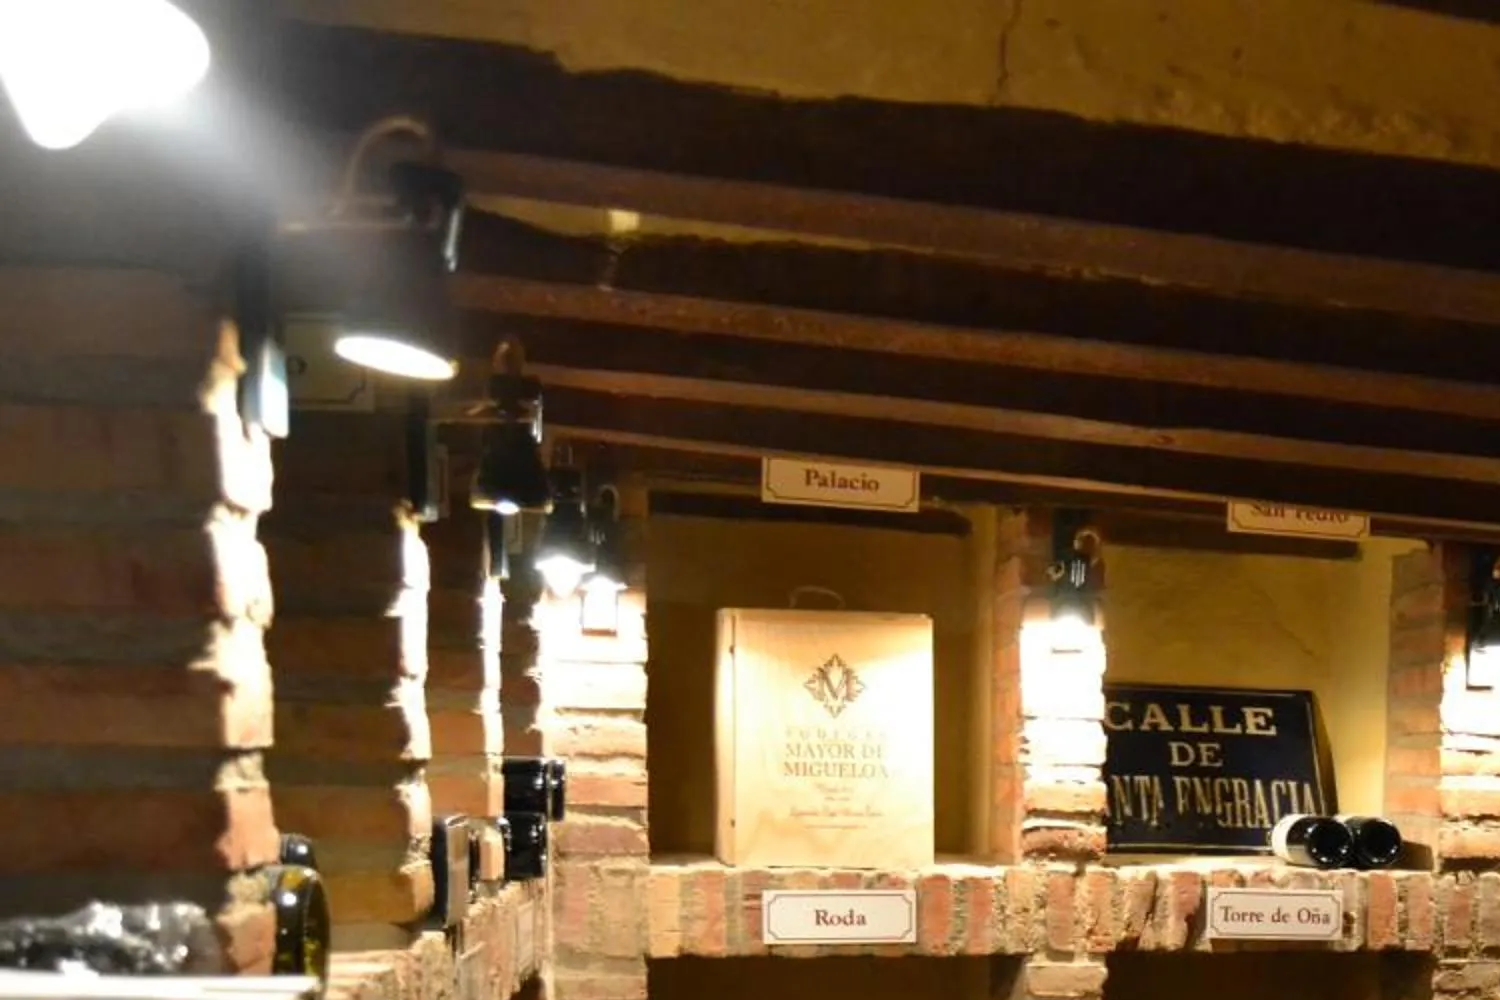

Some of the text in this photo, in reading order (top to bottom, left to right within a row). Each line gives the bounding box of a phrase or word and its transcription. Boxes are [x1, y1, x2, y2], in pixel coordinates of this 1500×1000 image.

[804, 468, 880, 493] Palacio
[1104, 702, 1277, 736] CALLE
[786, 743, 855, 759] MAYOR
[1168, 741, 1223, 767] DE
[1104, 775, 1166, 826] NTA
[815, 908, 867, 926] Roda
[1220, 906, 1265, 923] Torre
[1271, 906, 1291, 923] de
